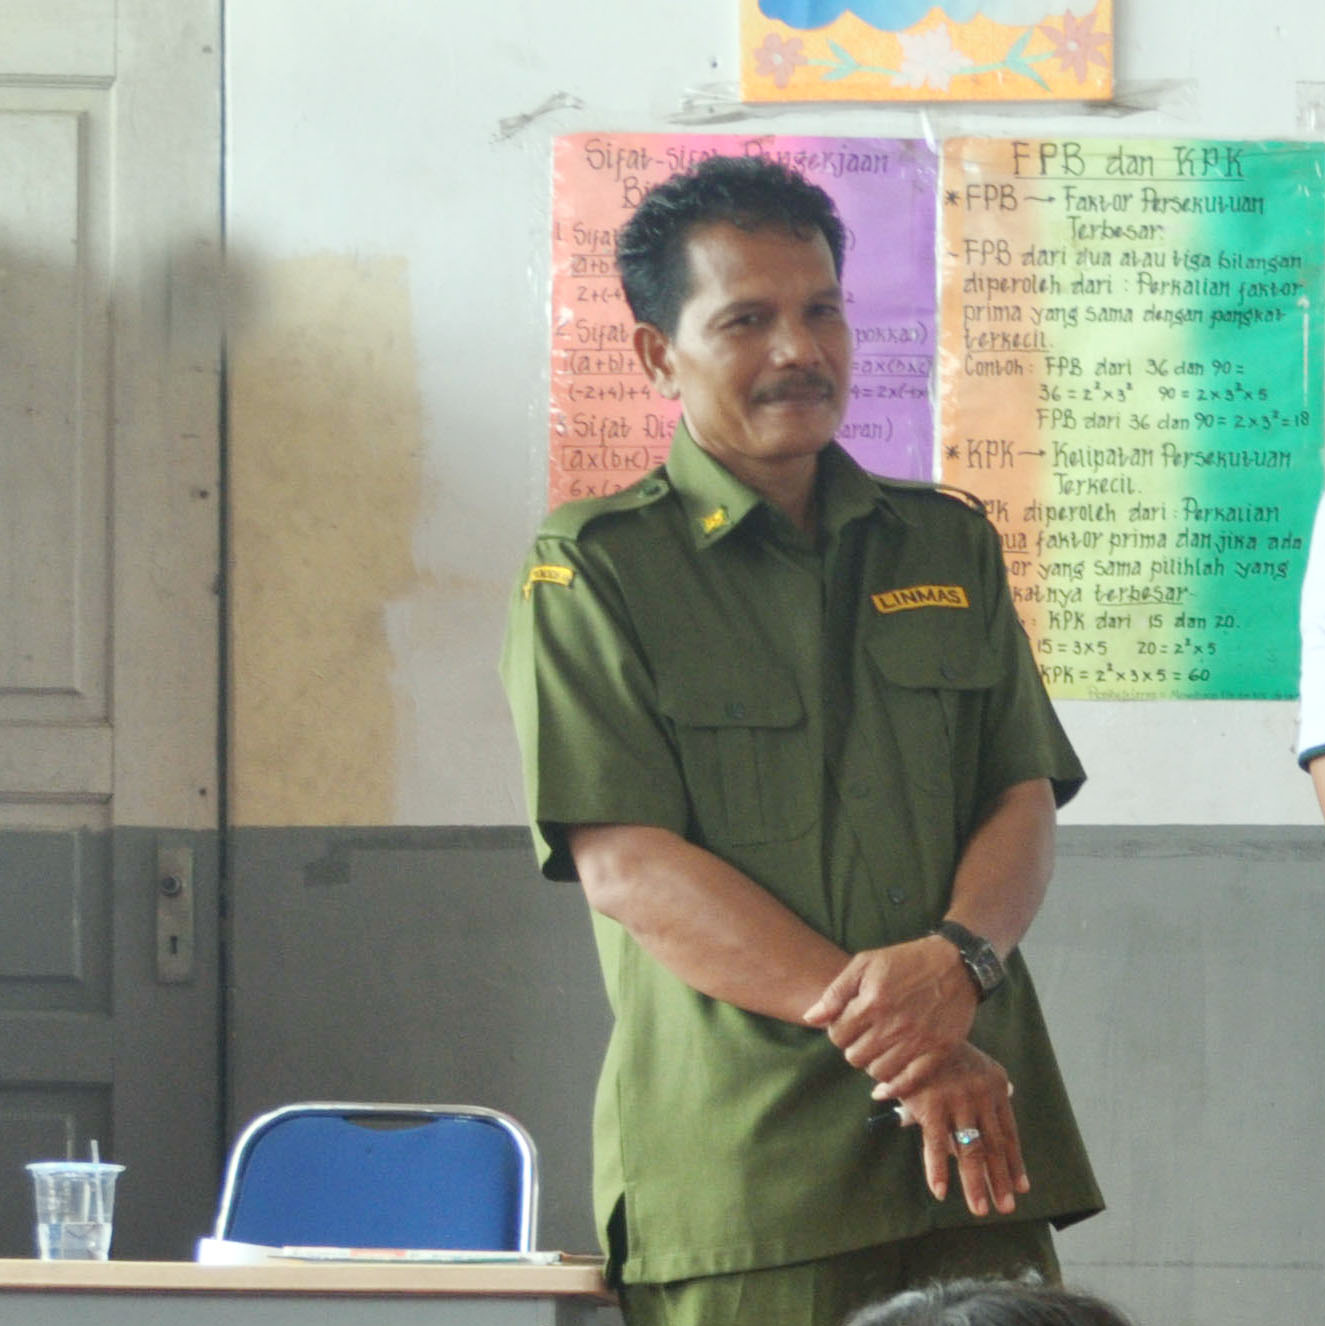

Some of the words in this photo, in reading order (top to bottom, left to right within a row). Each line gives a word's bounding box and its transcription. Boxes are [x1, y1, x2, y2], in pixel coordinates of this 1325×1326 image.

[1011, 141, 1086, 176] FPB
[1105, 145, 1154, 176] dan
[1173, 146, 1243, 177] KPK
[965, 184, 1018, 212] FPB
[1063, 186, 1134, 212] Faktor
[1141, 187, 1265, 214] Persekutuan
[963, 239, 1012, 266] FPB
[1021, 245, 1066, 266] dari
[1076, 247, 1112, 267] dua
[1120, 250, 1166, 268] atau
[1172, 250, 1212, 271] tiga
[1217, 250, 1302, 275] bilangan
[963, 272, 1061, 301] diperoleh
[1070, 272, 1113, 295] dari
[1137, 272, 1230, 297] Perkalian
[1238, 281, 1305, 306] faktor
[964, 304, 1022, 332] prima
[1030, 306, 1079, 329] yang
[1085, 306, 1133, 323] sama
[1143, 304, 1204, 329] dengan
[1210, 307, 1286, 330] pangkat
[575, 319, 629, 350] Sifat
[1045, 356, 1083, 377] FPB
[1095, 356, 1133, 376] dari
[1145, 359, 1169, 376] 36
[1174, 360, 1205, 376] dan
[1211, 359, 1232, 376] 90
[1039, 383, 1062, 402] 36
[1158, 385, 1176, 401] 90
[573, 413, 632, 449] Sifat
[1036, 408, 1077, 430] FPB
[1083, 411, 1121, 430] dari
[1128, 414, 1151, 430] 36
[1157, 413, 1190, 430] dan
[1194, 411, 1215, 429] 90
[1294, 411, 1310, 428] 18
[966, 438, 1015, 470] KPK
[1052, 440, 1154, 473] Kelipatan
[1162, 442, 1292, 468] Persekutuan
[1024, 499, 1116, 527] diperoleh
[1128, 501, 1166, 522] dari
[1182, 497, 1280, 522] Perkalian
[1036, 530, 1104, 557] faktor
[1109, 529, 1168, 555] prima
[1175, 527, 1211, 549] dan
[1267, 532, 1302, 550] ada
[1037, 560, 1085, 581] yang
[1094, 560, 1142, 576] sama
[1150, 557, 1225, 582] pilihlah
[1235, 559, 1289, 580] yang
[880, 588, 962, 609] LINMAS
[1048, 610, 1085, 630] KPK
[1096, 611, 1131, 630] dari
[1149, 614, 1163, 629] 15
[1174, 612, 1207, 630] dan
[1037, 638, 1053, 654] 15
[1137, 641, 1157, 655] 20
[1040, 664, 1075, 685] KPK
[1187, 668, 1211, 682] 60
